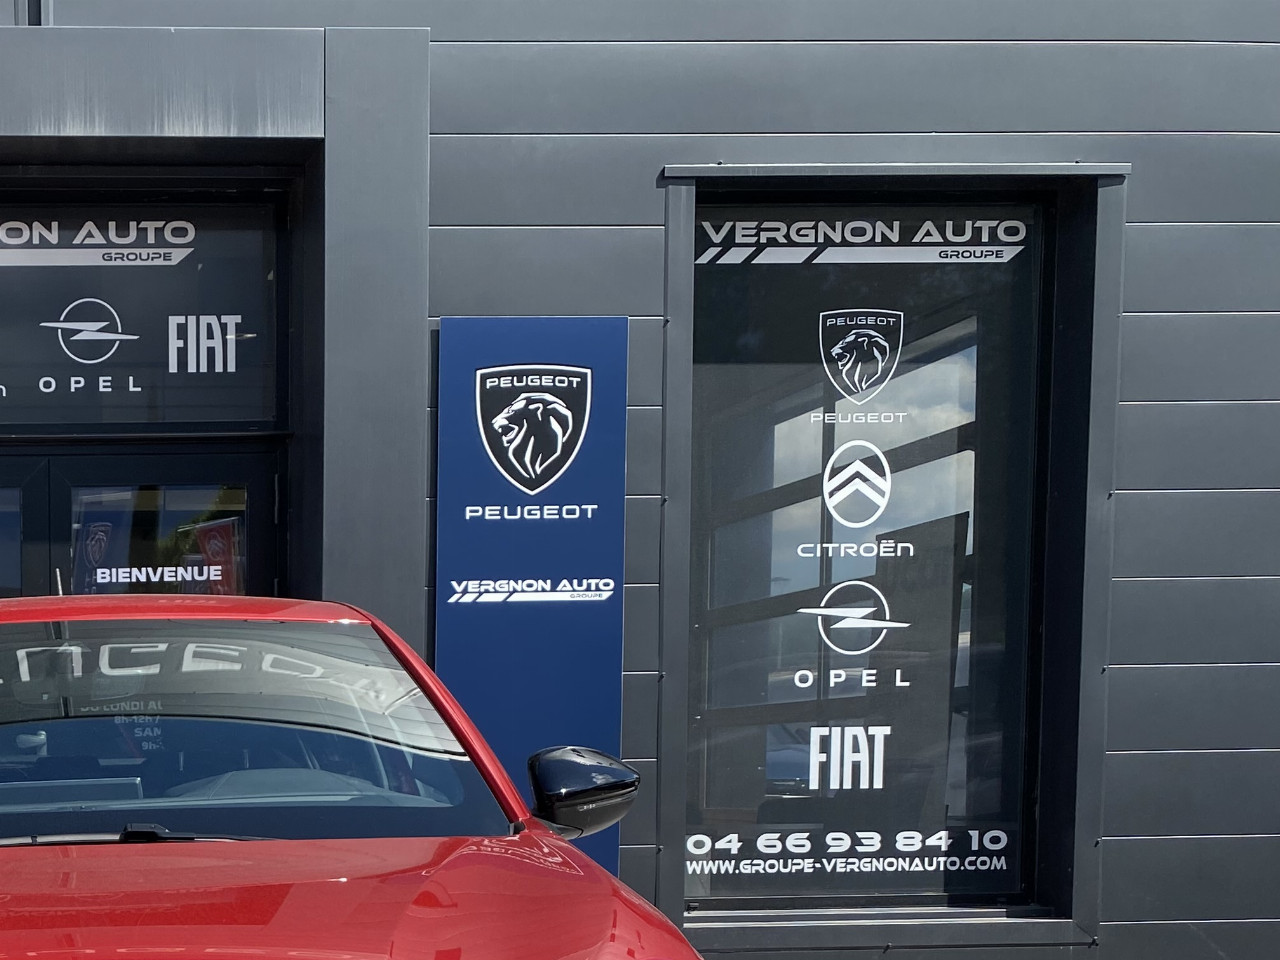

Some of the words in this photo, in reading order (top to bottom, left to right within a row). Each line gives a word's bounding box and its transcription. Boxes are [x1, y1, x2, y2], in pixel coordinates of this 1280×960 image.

[72, 220, 197, 245] AUTO
[701, 220, 901, 244] VERGNON
[911, 219, 1027, 243] AUTO
[101, 250, 173, 263] GROUPE
[938, 249, 1005, 260] GROUPE
[826, 316, 897, 327] PEUGEOT
[168, 314, 242, 373] FIAT
[38, 374, 142, 393] OPEL
[486, 374, 582, 390] PEUGEOT
[810, 411, 908, 424] PEUGEOT
[465, 504, 599, 520] PEUGEOT
[96, 565, 223, 584] BIENVENUE
[450, 579, 550, 592] VERGNON
[555, 578, 615, 592] AUTO
[793, 668, 911, 688] OPEL
[808, 725, 892, 790] FIAT
[686, 833, 743, 855] 04
[756, 832, 812, 854] 66
[825, 831, 882, 853] 93
[895, 830, 953, 852] 84
[968, 829, 1008, 851] 10
[686, 856, 1007, 875] WWW.GROUPE-VERGNONAUTO.COM
